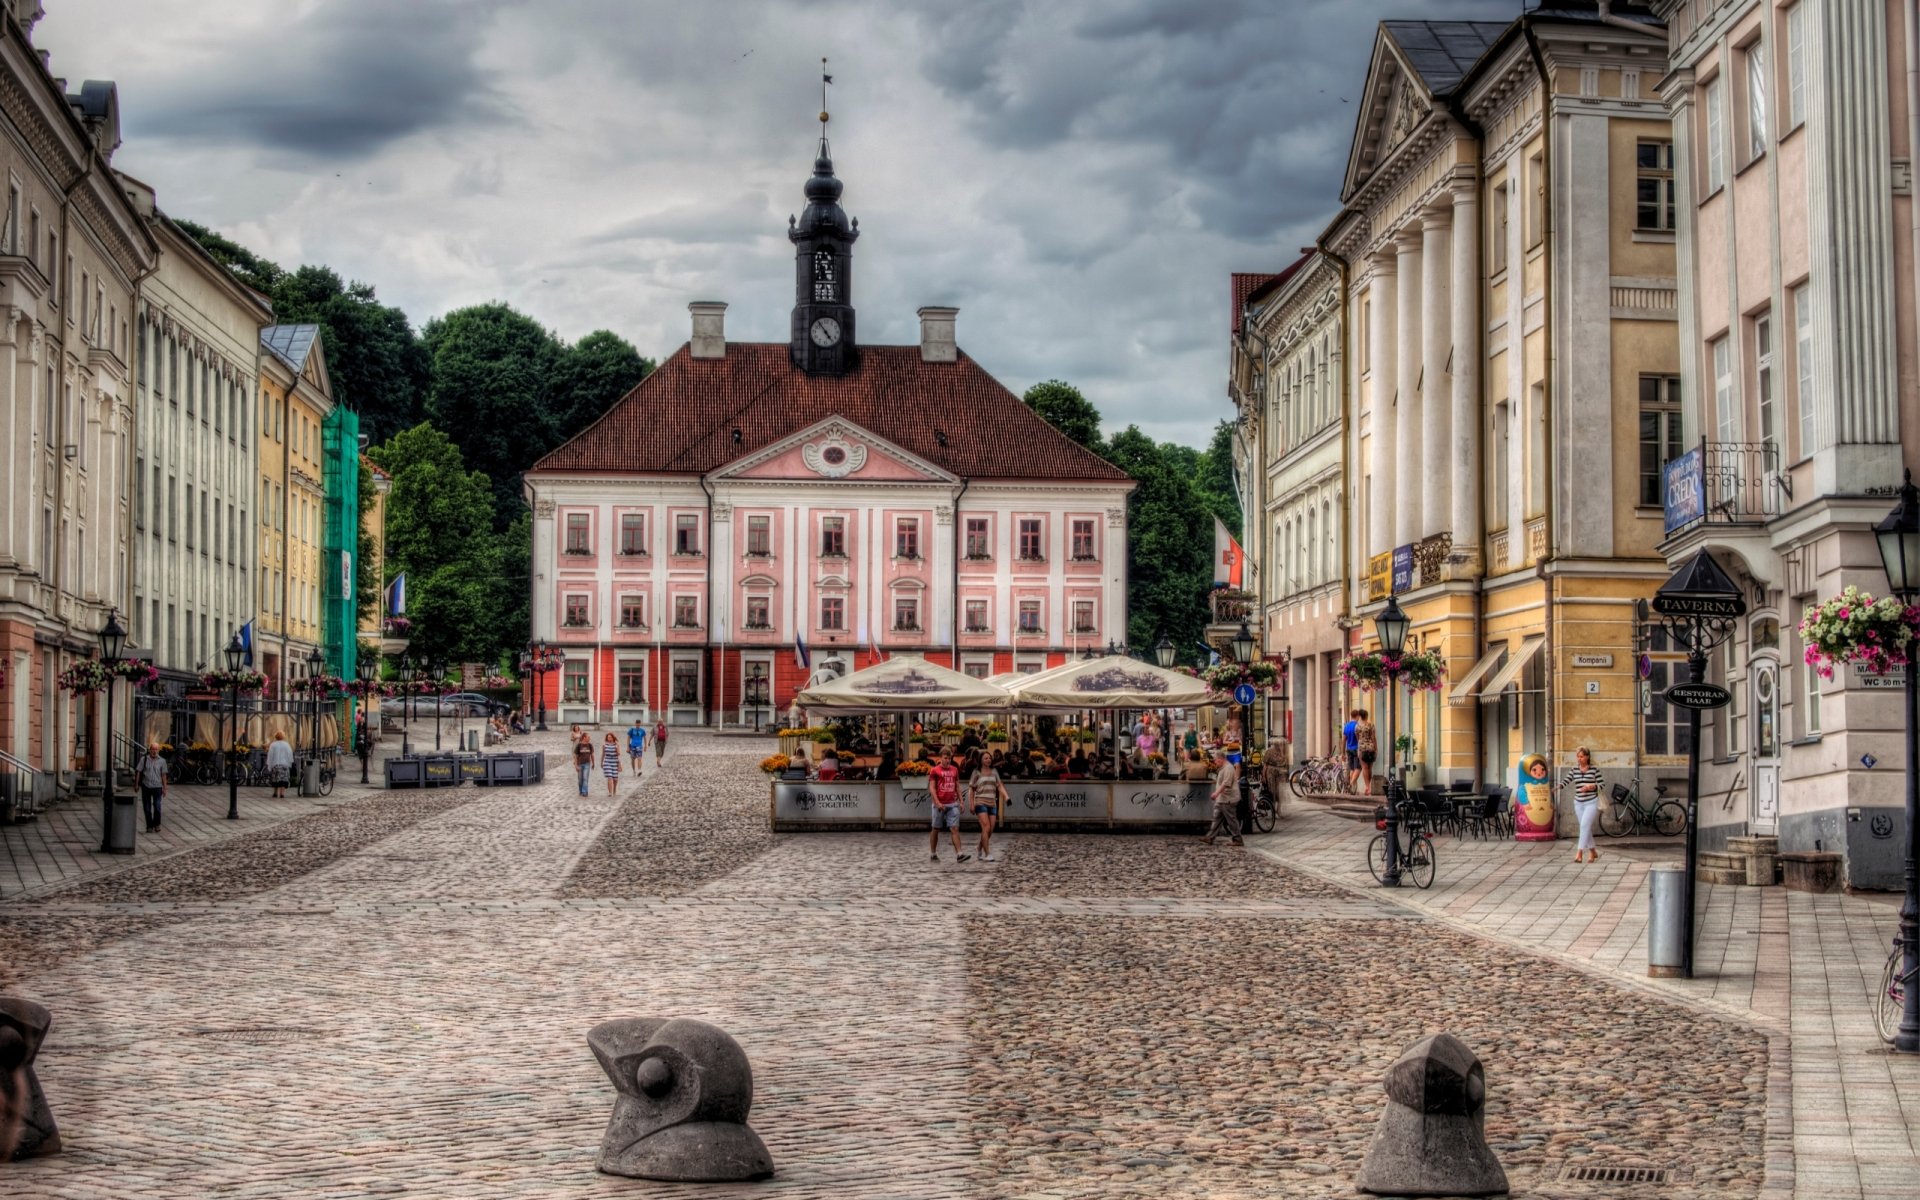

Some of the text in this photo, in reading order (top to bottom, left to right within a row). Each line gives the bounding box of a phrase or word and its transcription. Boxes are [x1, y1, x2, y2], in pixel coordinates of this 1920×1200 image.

[1668, 472, 1699, 508] CREDO
[1661, 599, 1737, 613] TAVERNA
[1578, 656, 1607, 665] Kompanii
[1863, 678, 1880, 686] WC
[1590, 683, 1596, 692] 2
[1673, 689, 1725, 699] RESTORAN
[1686, 696, 1712, 705] BAAR
